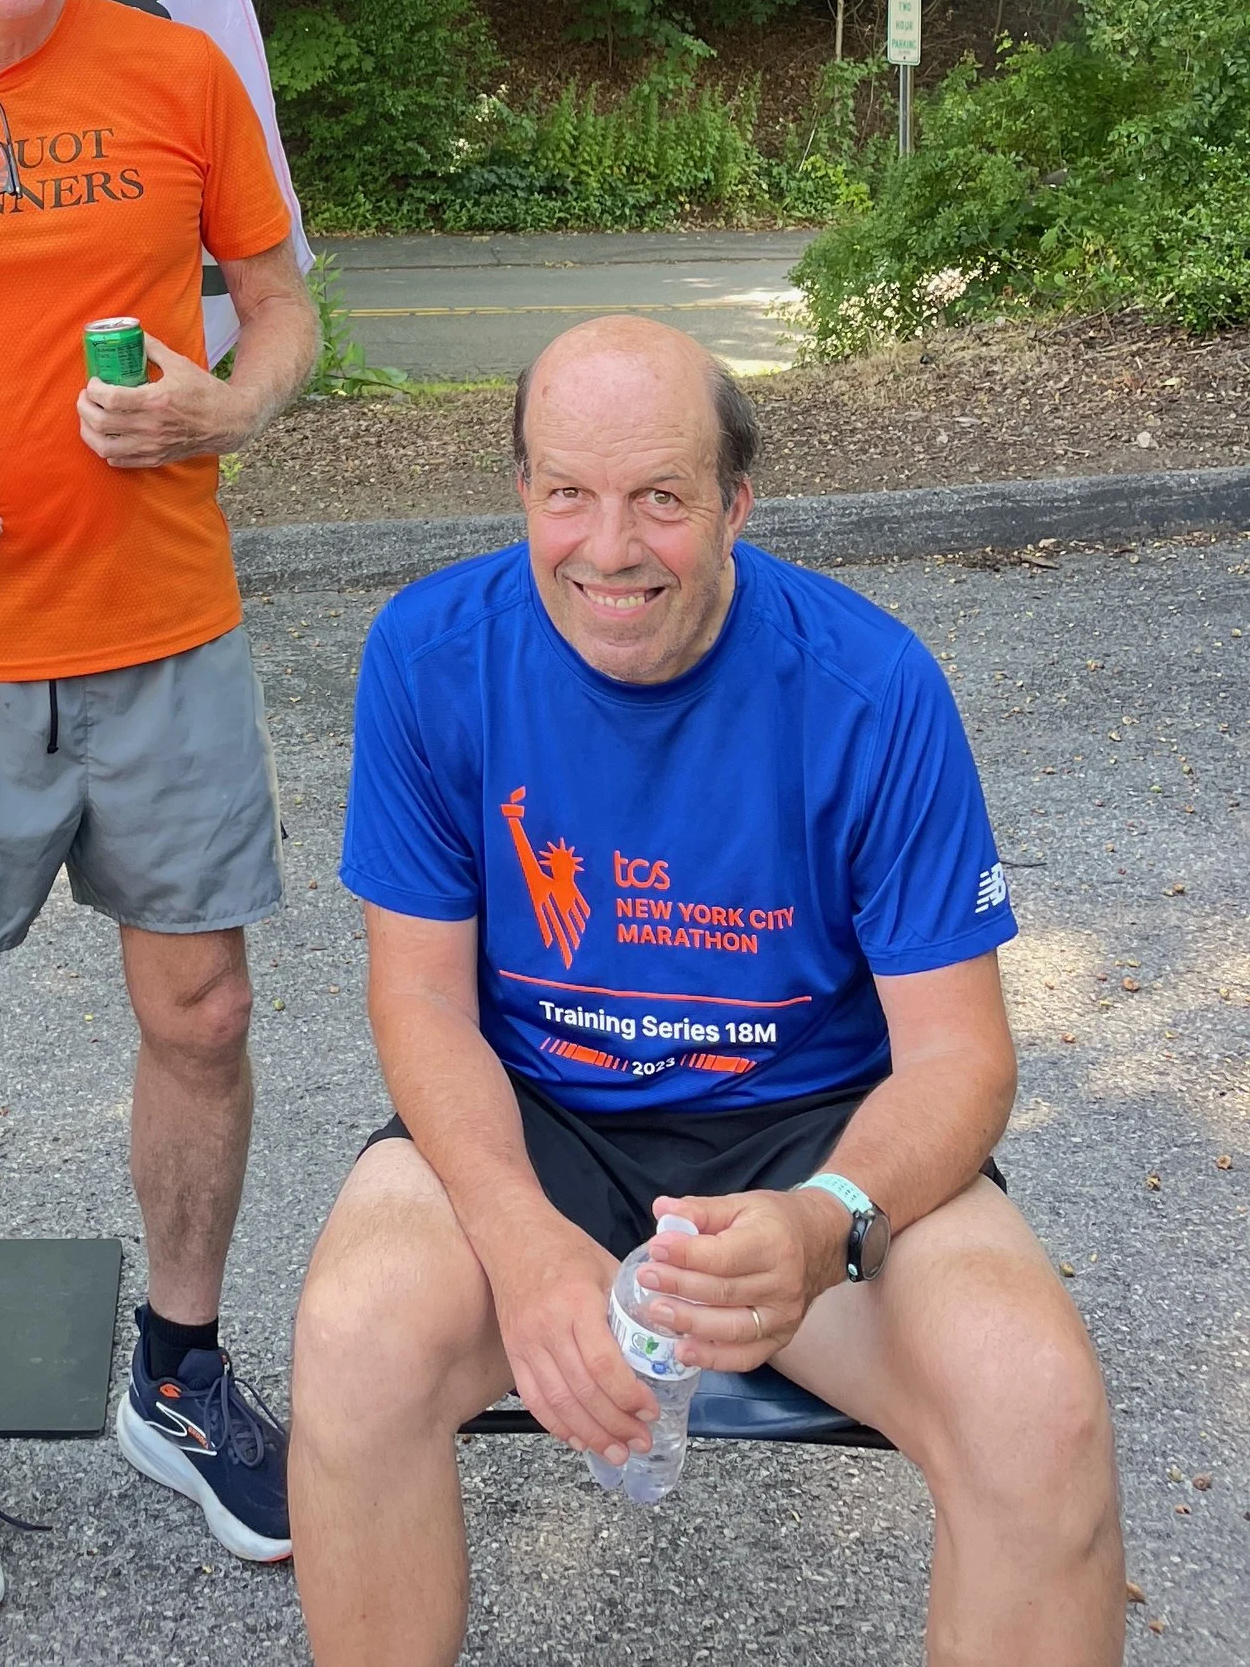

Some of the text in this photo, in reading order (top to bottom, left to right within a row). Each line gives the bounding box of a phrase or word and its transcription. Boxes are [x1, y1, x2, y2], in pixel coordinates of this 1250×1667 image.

[898, 1, 912, 12] TWO
[895, 20, 914, 31] HOUR
[891, 38, 917, 51] PARKING
[616, 897, 795, 931] NEW YORK CITY
[617, 923, 759, 955] MARATHON
[538, 1000, 778, 1043] Training Series 18M
[632, 1057, 676, 1076] 2023
